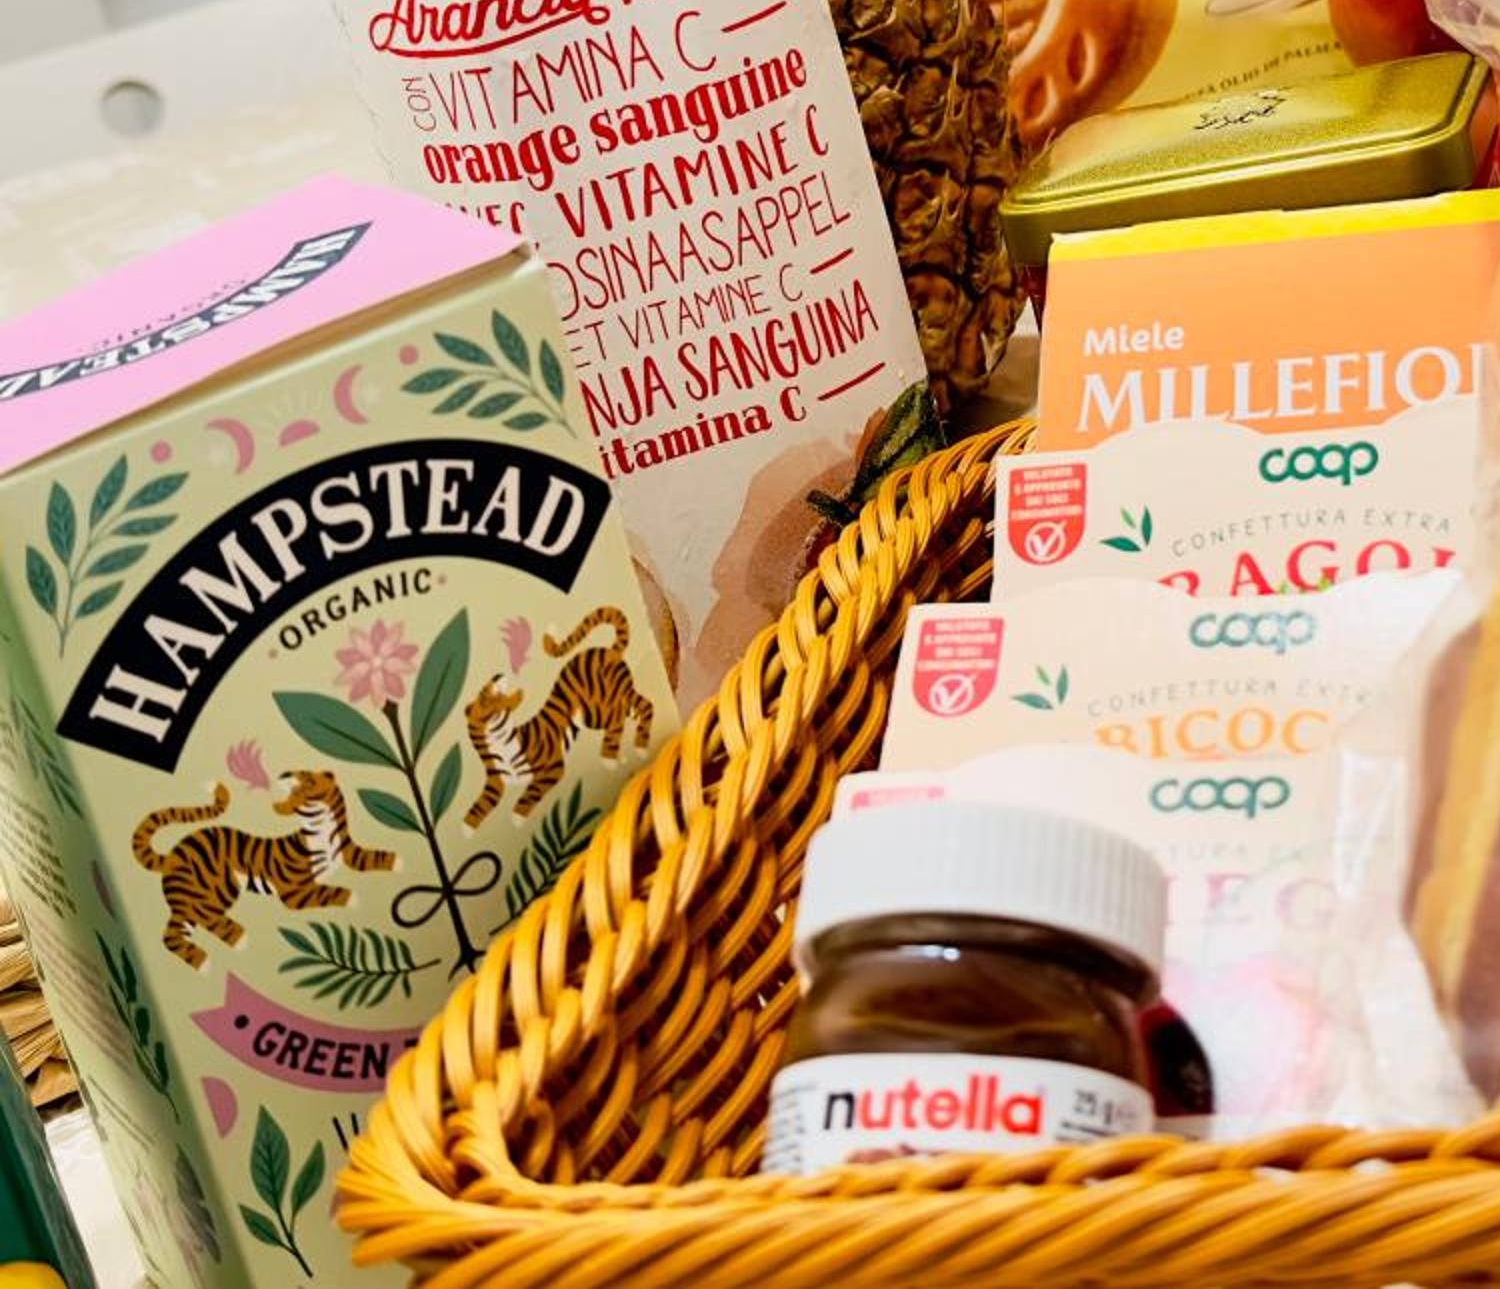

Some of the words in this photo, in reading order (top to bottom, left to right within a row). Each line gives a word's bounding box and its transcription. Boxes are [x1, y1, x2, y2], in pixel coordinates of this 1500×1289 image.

[674, 11, 718, 73] C
[423, 120, 582, 193] orange
[588, 46, 809, 155] sanguine
[555, 120, 800, 239] VITAMINE
[805, 103, 830, 160] C
[616, 272, 775, 351] VITAMINE
[778, 261, 804, 304] C
[677, 277, 881, 404] SANGUINA
[1081, 320, 1186, 358] Miele
[778, 384, 809, 425] C
[1258, 440, 1379, 487] coop
[1171, 508, 1347, 559] CONFETTURA
[1361, 507, 1451, 534] EXTRA
[89, 457, 587, 745] HAMPSTEAD
[278, 567, 435, 652] ORGANIC
[1188, 610, 1316, 657] coop
[1086, 678, 1278, 718] CONFETTURA
[1149, 774, 1292, 820] coop
[252, 1020, 390, 1080] GREEN
[822, 1073, 1044, 1136] nutella
